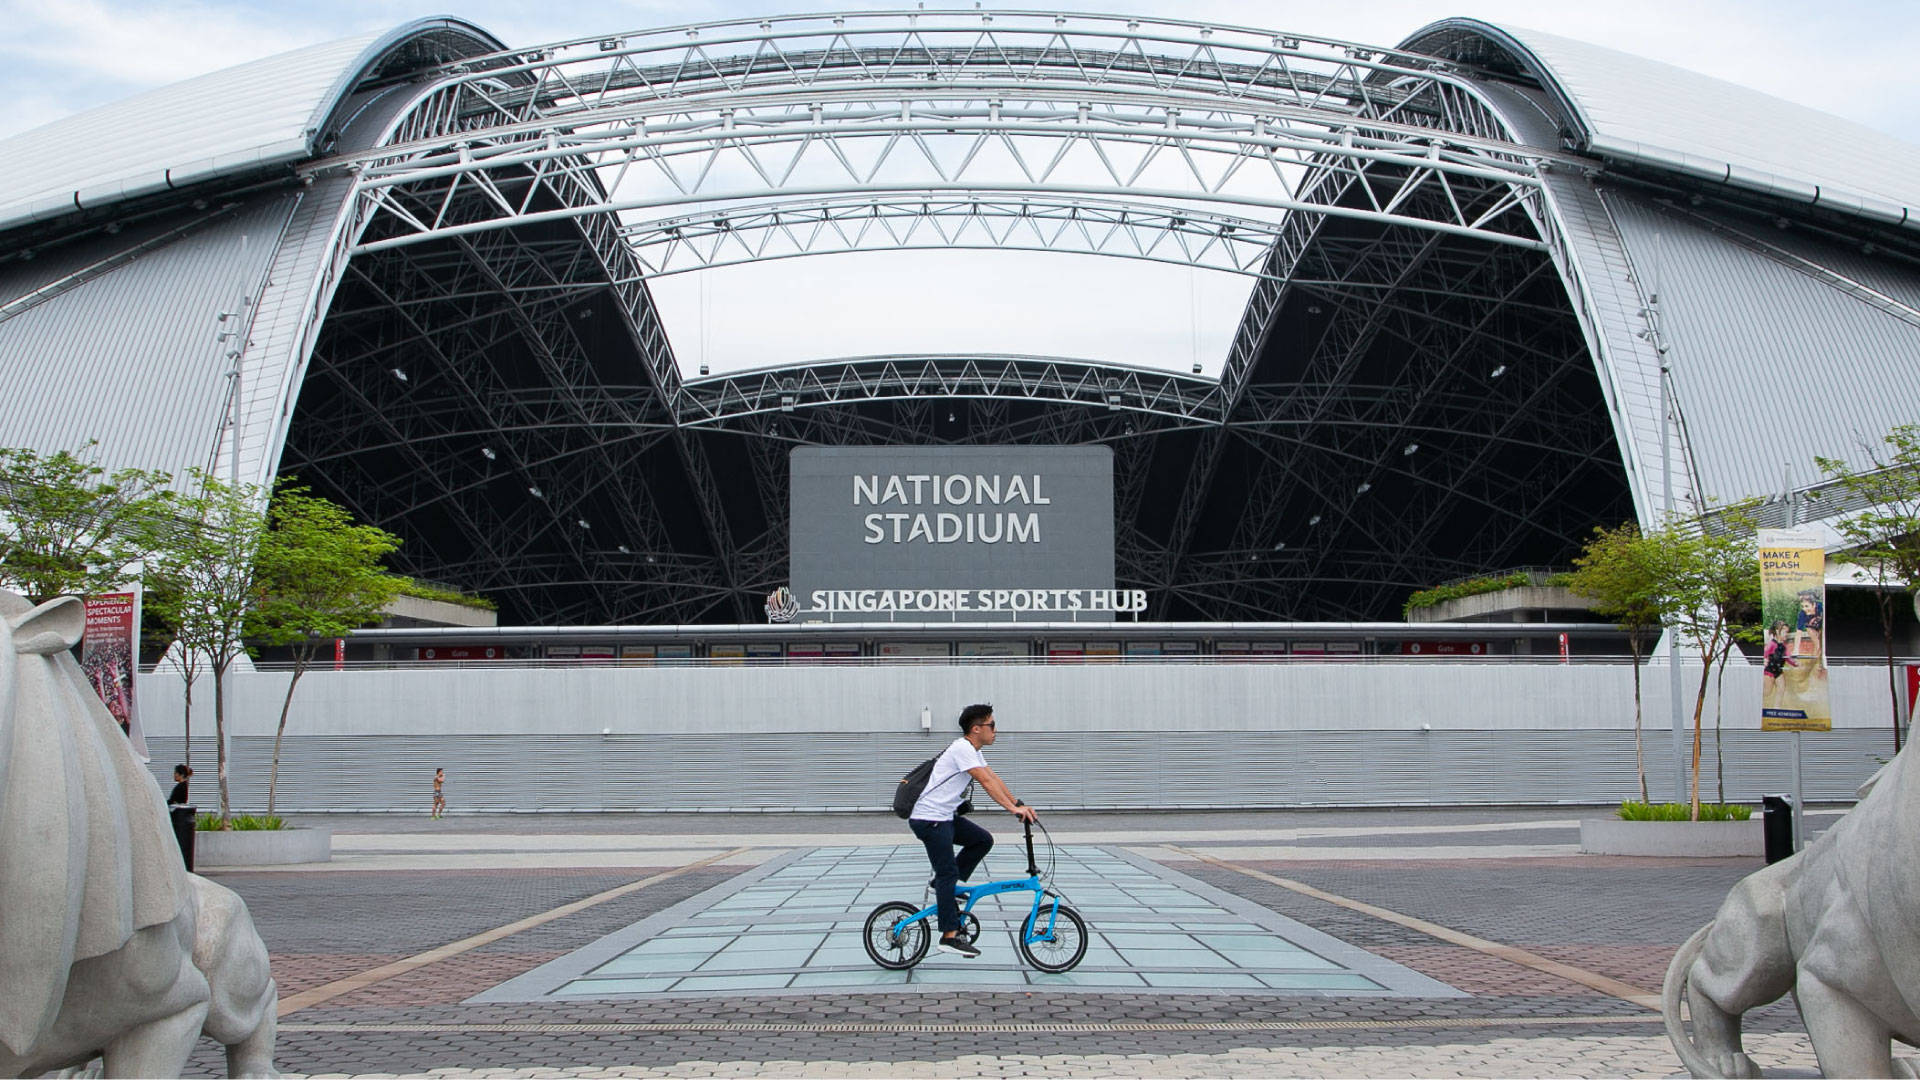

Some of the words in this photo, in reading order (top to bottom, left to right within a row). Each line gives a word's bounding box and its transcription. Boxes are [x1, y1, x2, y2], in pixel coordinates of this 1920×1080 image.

[853, 474, 1051, 505] NATIONAL
[864, 513, 1041, 543] STADIUM
[1763, 551, 1790, 559] MAKE
[1793, 551, 1800, 559] A
[1763, 561, 1800, 569] SPLASH
[811, 589, 969, 612] SINGAPORE
[977, 589, 1082, 612] SPORTS
[1089, 589, 1148, 612] HUB
[87, 606, 131, 616] SPECTACULAR
[87, 616, 121, 625] MOMENTS
